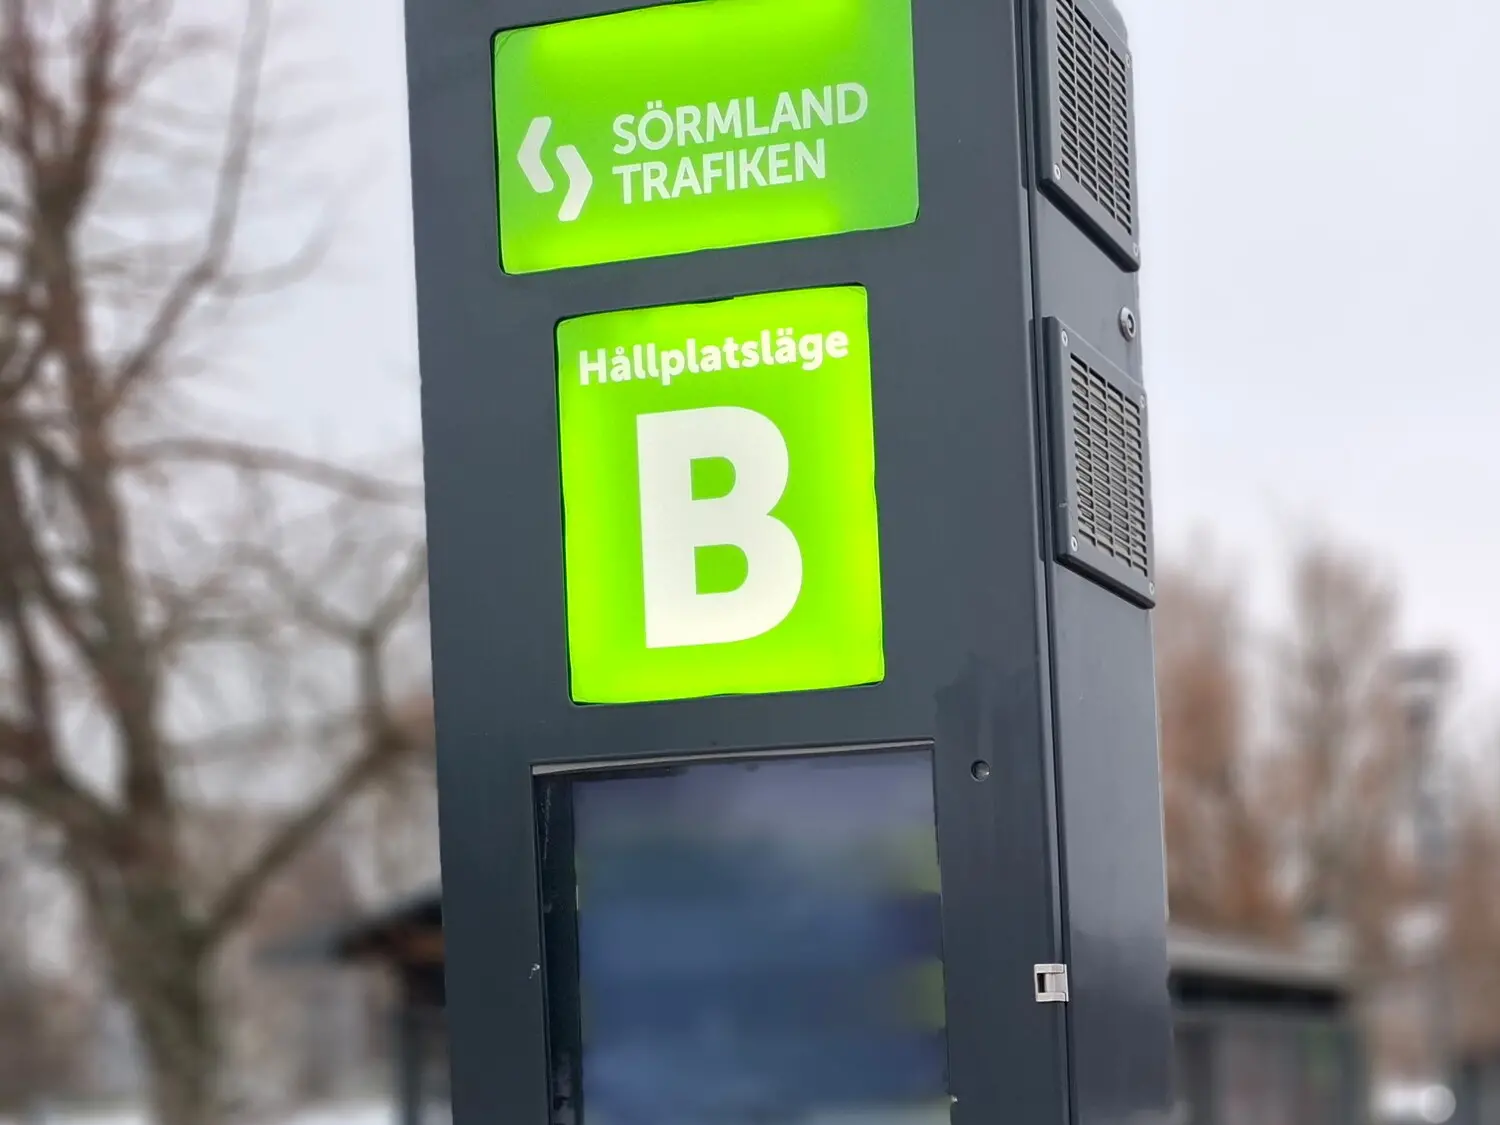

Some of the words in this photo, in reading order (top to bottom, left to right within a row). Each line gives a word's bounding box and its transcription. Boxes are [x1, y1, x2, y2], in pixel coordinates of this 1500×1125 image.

[612, 82, 869, 155] SÖRMLAND
[612, 138, 827, 205] TRAFIKEN
[579, 327, 849, 387] Hållplatsläge
[635, 405, 803, 649] B
